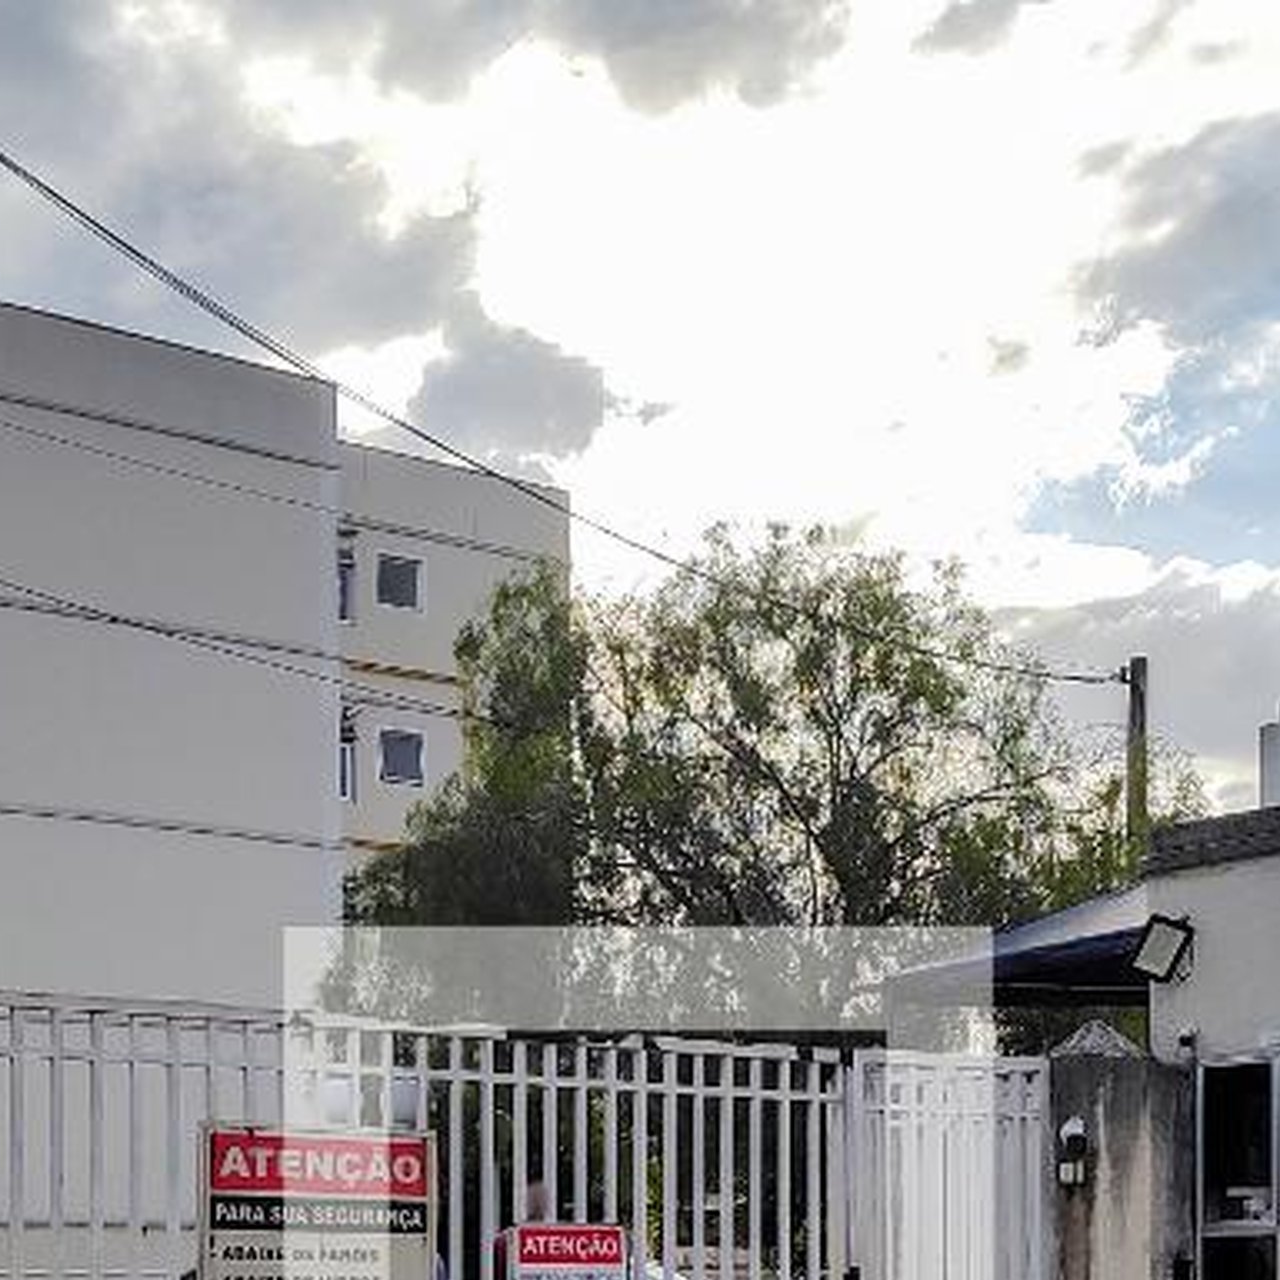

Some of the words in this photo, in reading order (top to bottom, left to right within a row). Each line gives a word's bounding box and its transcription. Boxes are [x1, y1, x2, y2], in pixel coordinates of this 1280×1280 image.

[220, 1145, 421, 1188] ATENÇÃO
[215, 1203, 264, 1222] PARA
[267, 1206, 307, 1225] SUA
[311, 1206, 424, 1230] SEGURANÇA
[521, 1234, 618, 1259] ATENÇÃO
